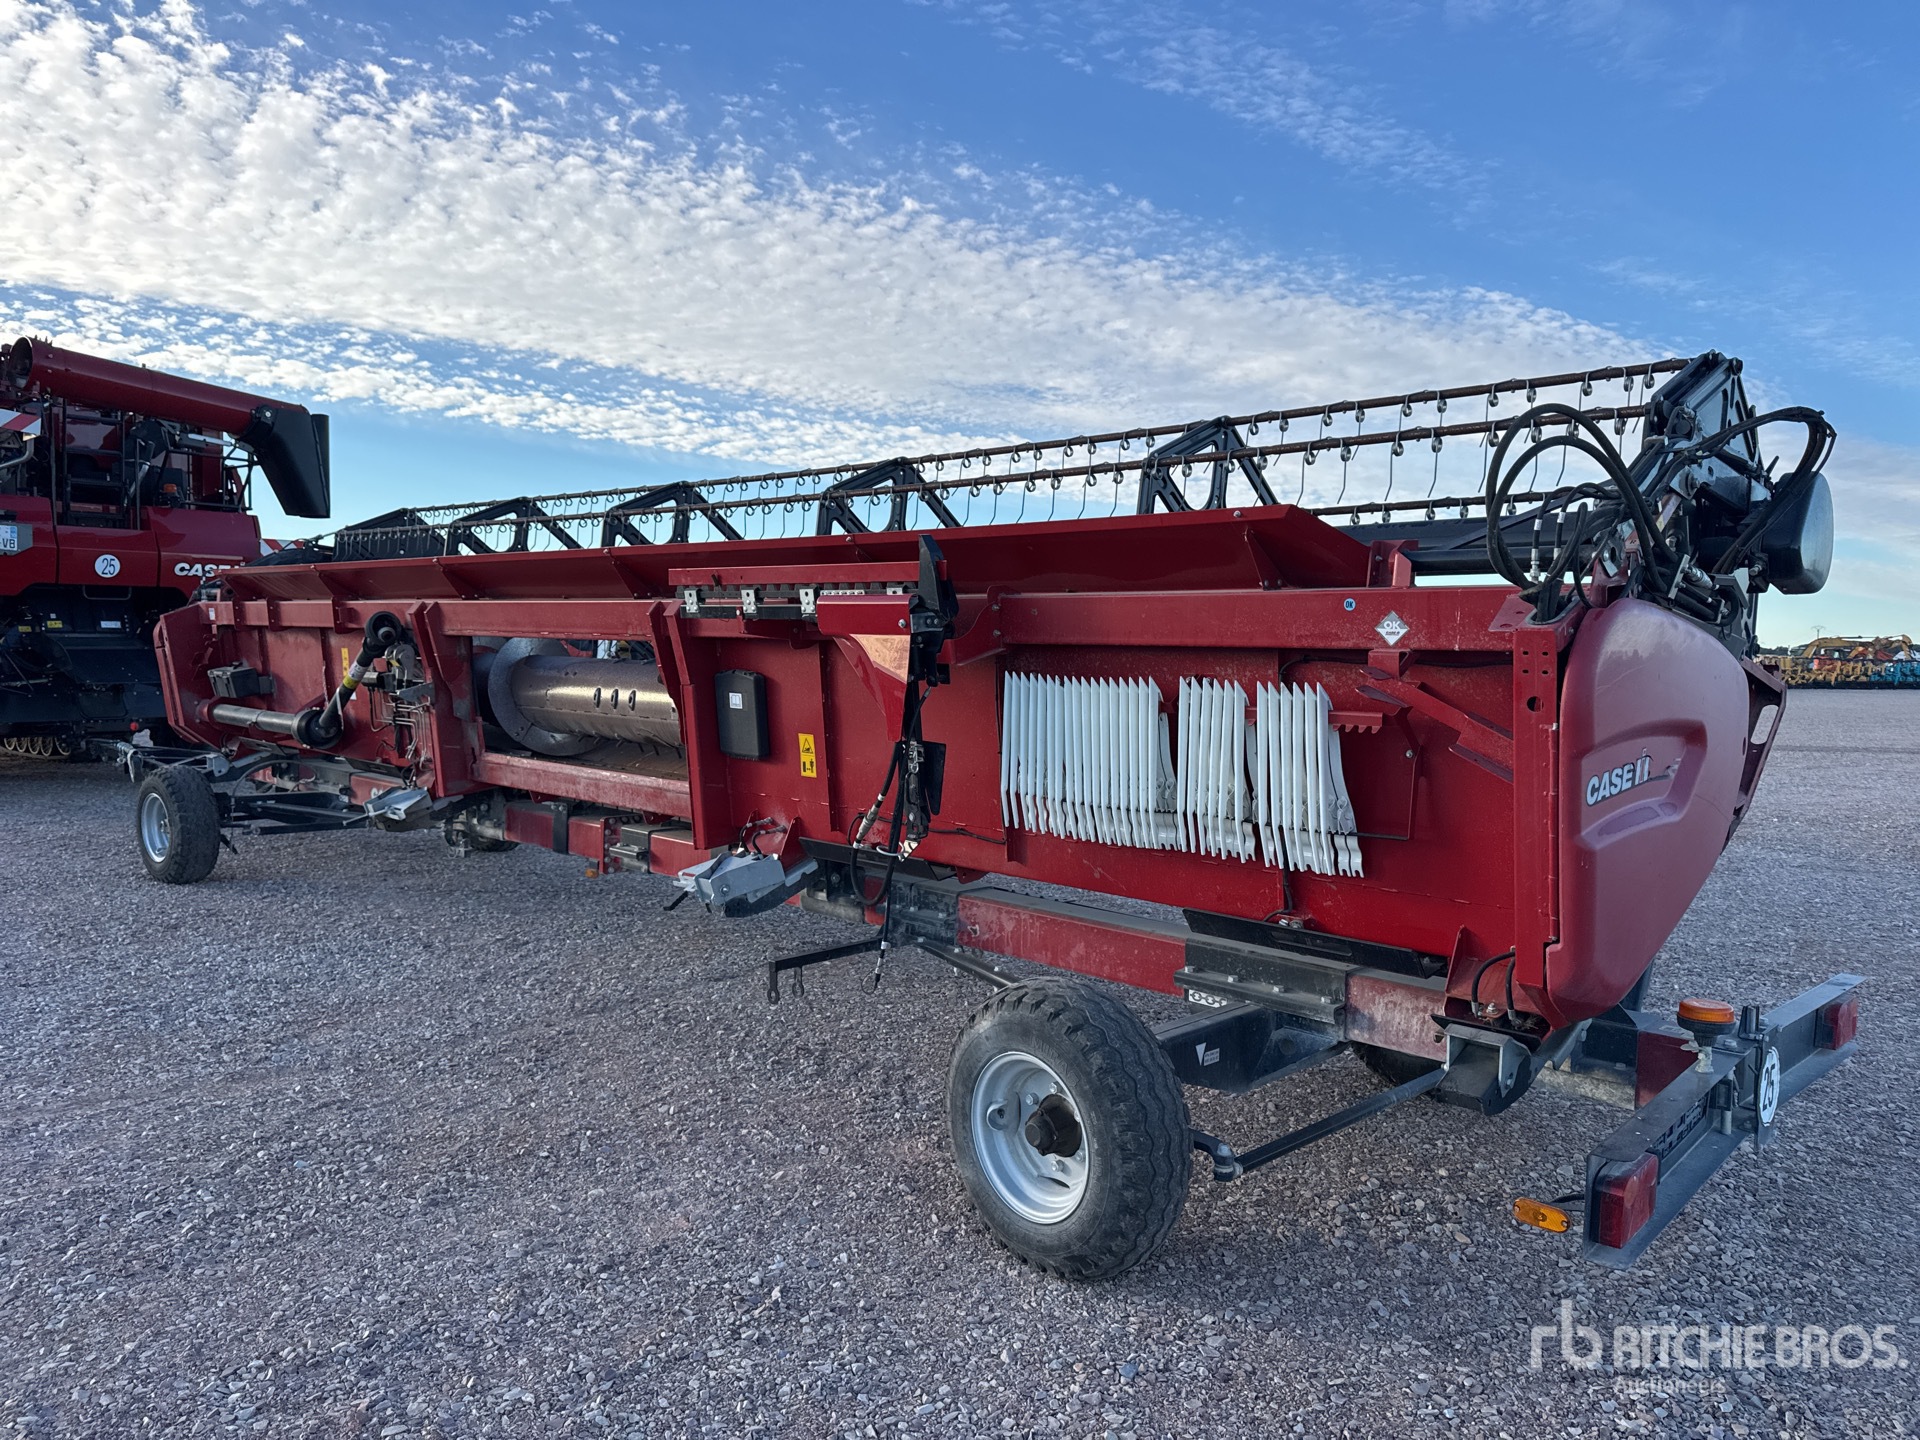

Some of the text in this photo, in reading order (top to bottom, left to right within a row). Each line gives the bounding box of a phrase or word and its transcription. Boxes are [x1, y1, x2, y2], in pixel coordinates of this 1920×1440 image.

[101, 558, 116, 575] 25
[1383, 621, 1400, 630] OK
[1586, 763, 1635, 806] CASE
[1763, 1064, 1776, 1112] 25
